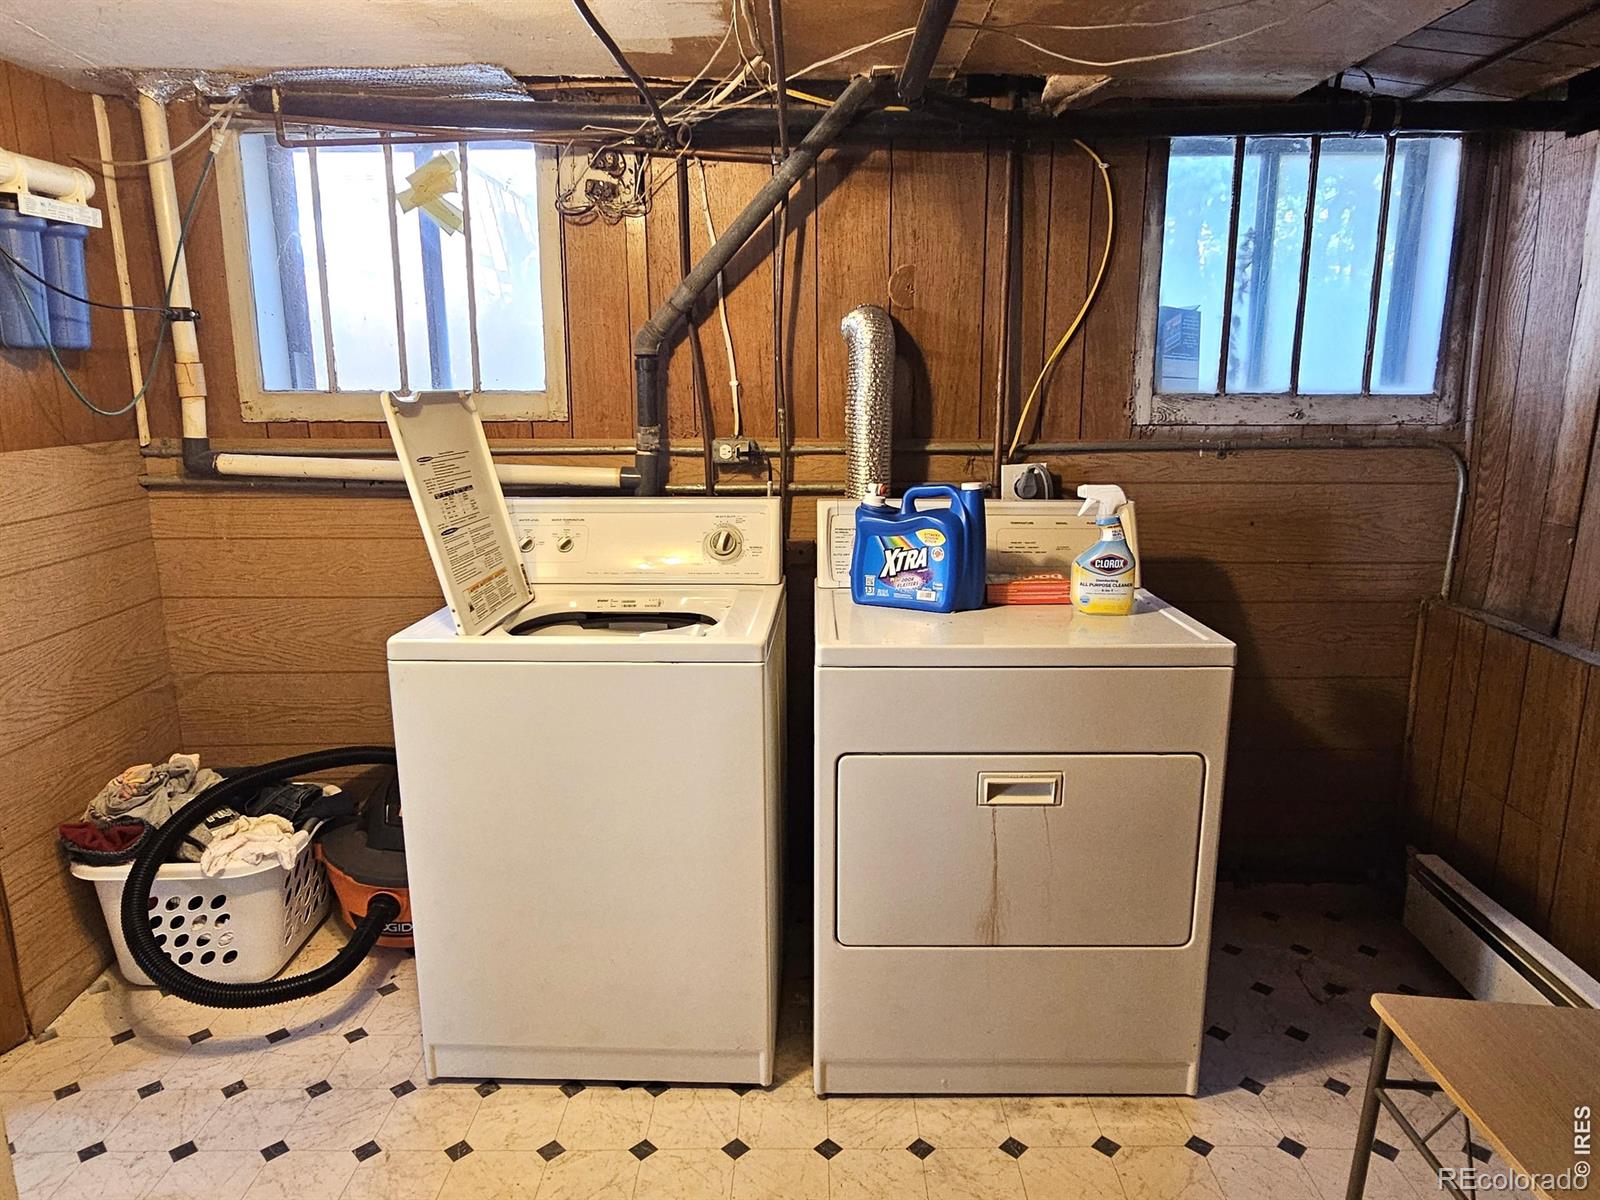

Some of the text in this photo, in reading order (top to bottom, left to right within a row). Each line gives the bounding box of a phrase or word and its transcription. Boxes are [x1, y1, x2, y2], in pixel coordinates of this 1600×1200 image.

[880, 548, 928, 578] XTRA
[1095, 559, 1124, 569] CLOROX
[383, 923, 413, 932] GID
